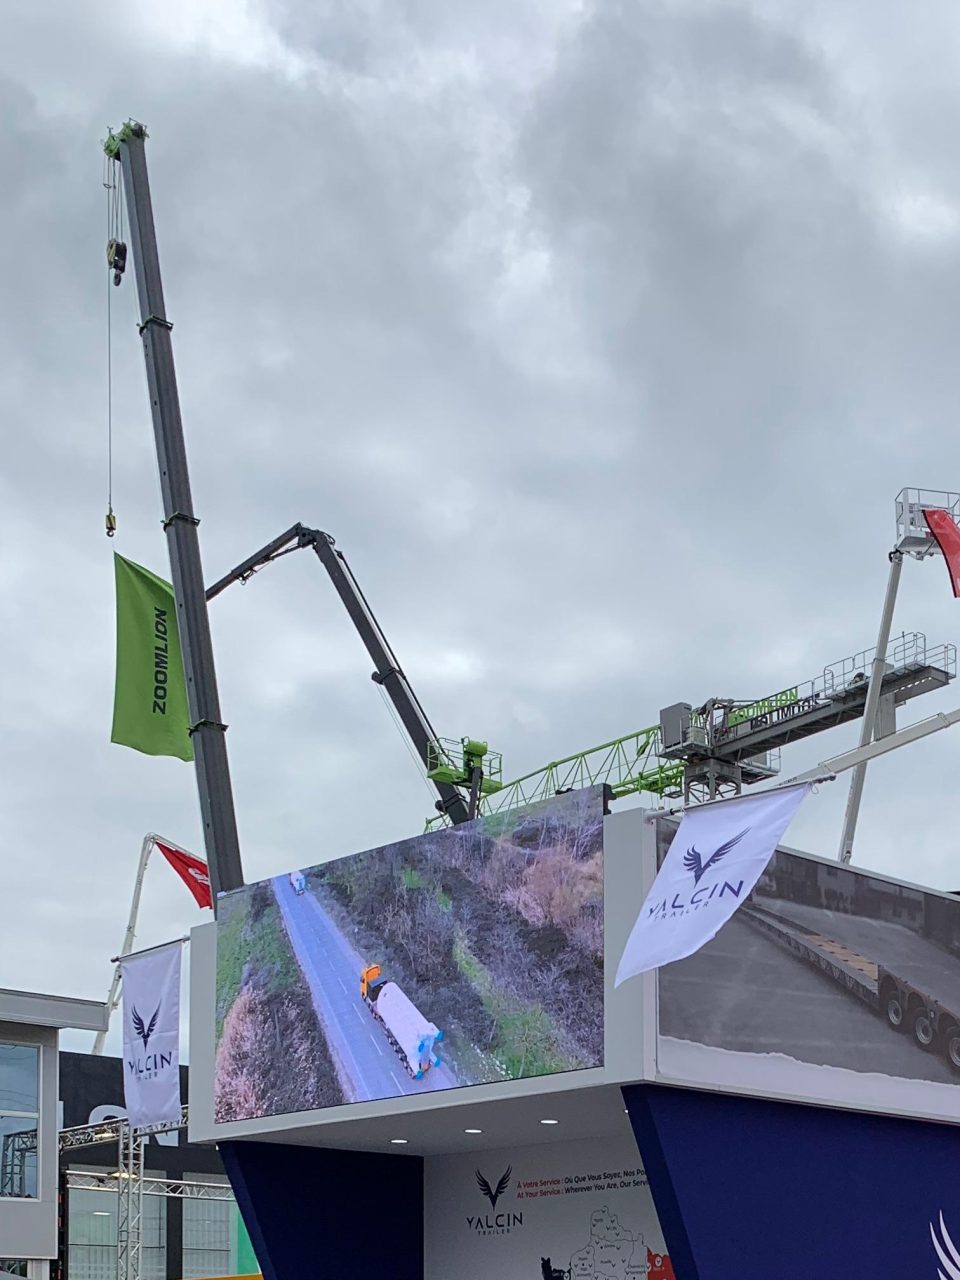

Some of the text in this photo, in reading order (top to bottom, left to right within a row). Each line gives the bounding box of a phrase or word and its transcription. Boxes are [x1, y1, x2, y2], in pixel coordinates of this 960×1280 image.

[152, 606, 169, 715] ZOOMLION
[732, 687, 798, 723] OOMLION
[648, 880, 744, 918] YALCIN
[525, 1190, 539, 1198] Your
[540, 1188, 561, 1197] Service
[565, 1186, 593, 1195] Wherever
[594, 1184, 606, 1192] You
[620, 1180, 632, 1188] Our
[540, 1178, 561, 1187] Service
[575, 1175, 587, 1184] Que
[587, 1173, 602, 1182] Vous
[623, 1170, 635, 1178] Nos
[466, 1212, 523, 1230] YALCIN
